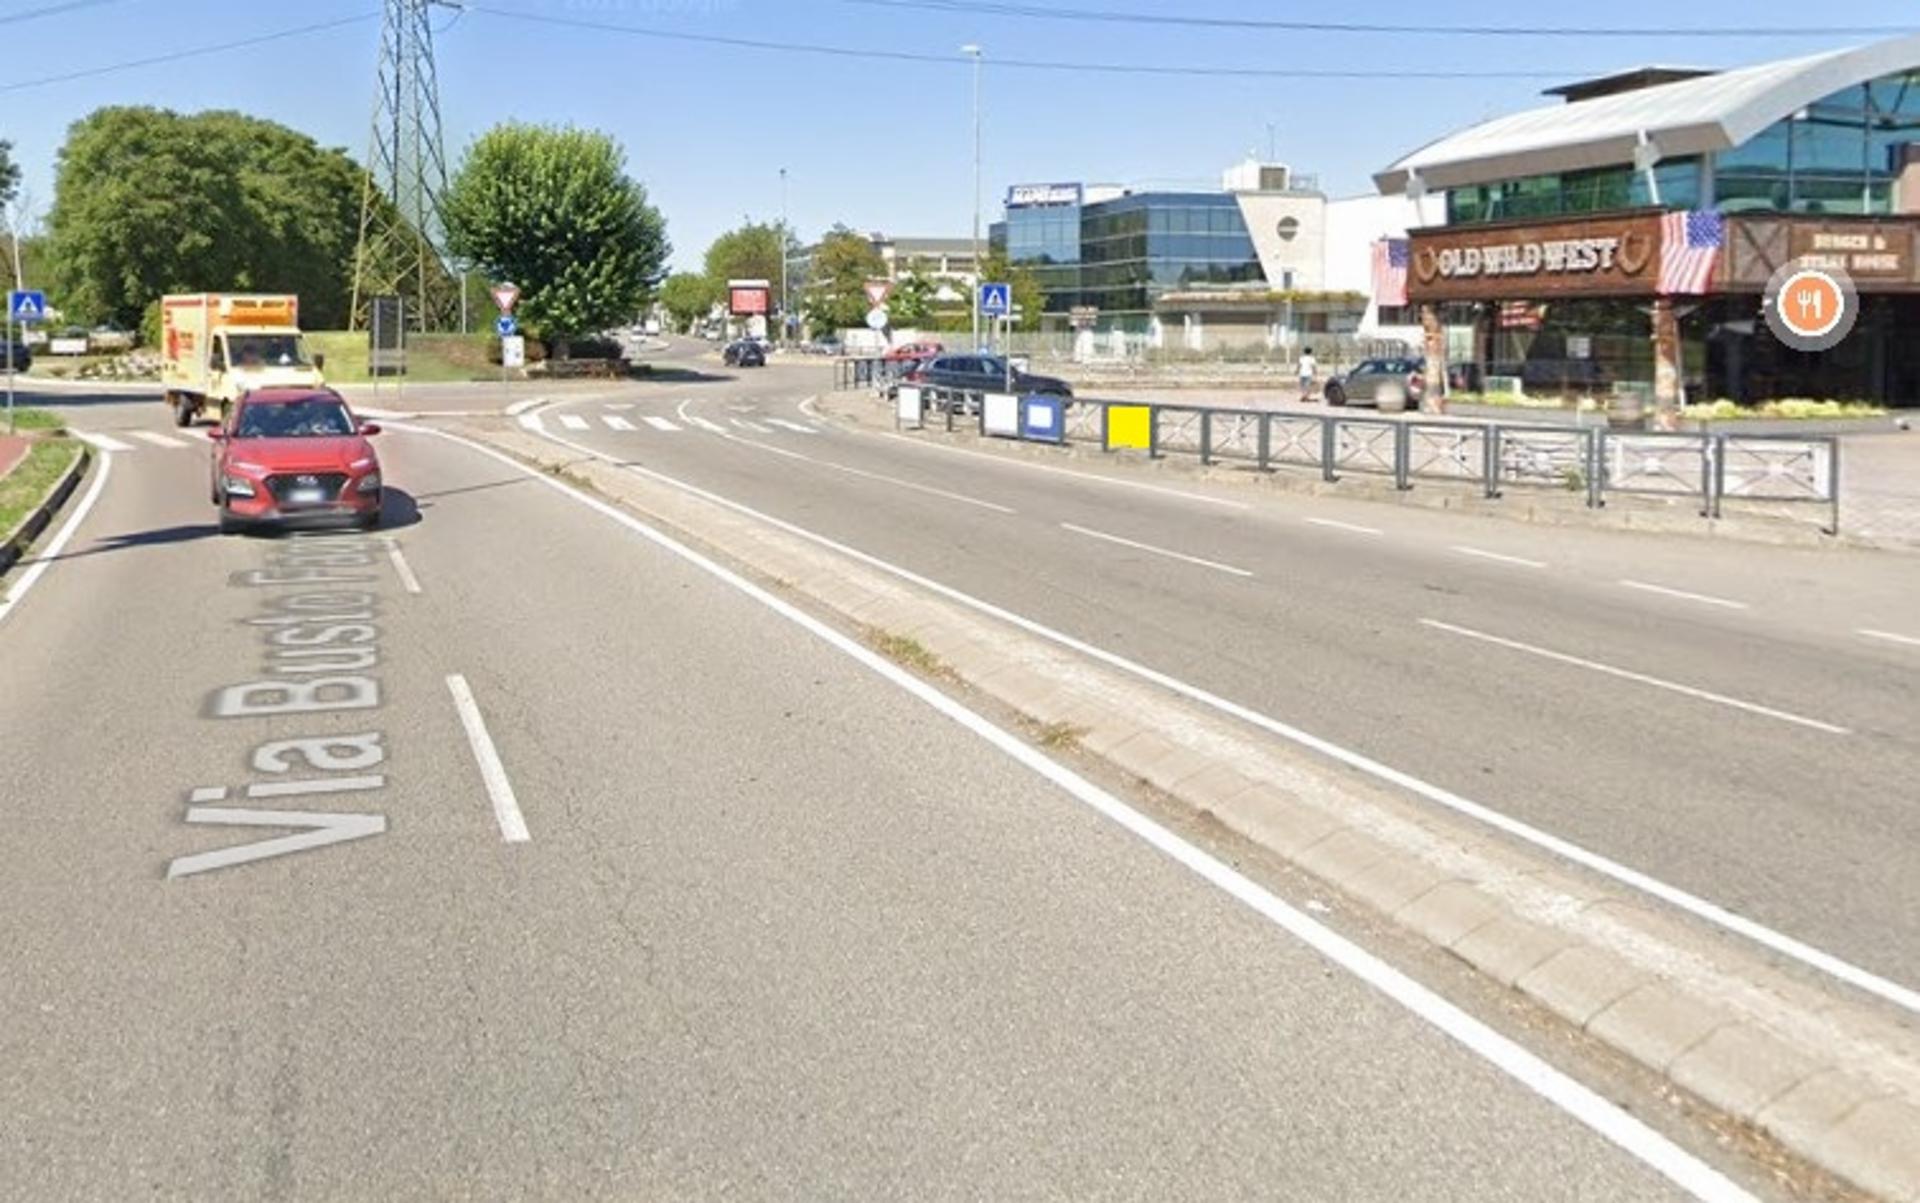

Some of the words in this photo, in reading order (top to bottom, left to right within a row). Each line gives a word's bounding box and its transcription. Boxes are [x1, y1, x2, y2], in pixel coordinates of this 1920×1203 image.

[1438, 248, 1481, 276] OLD
[1482, 243, 1541, 274] WILD
[1542, 237, 1618, 271] WEST
